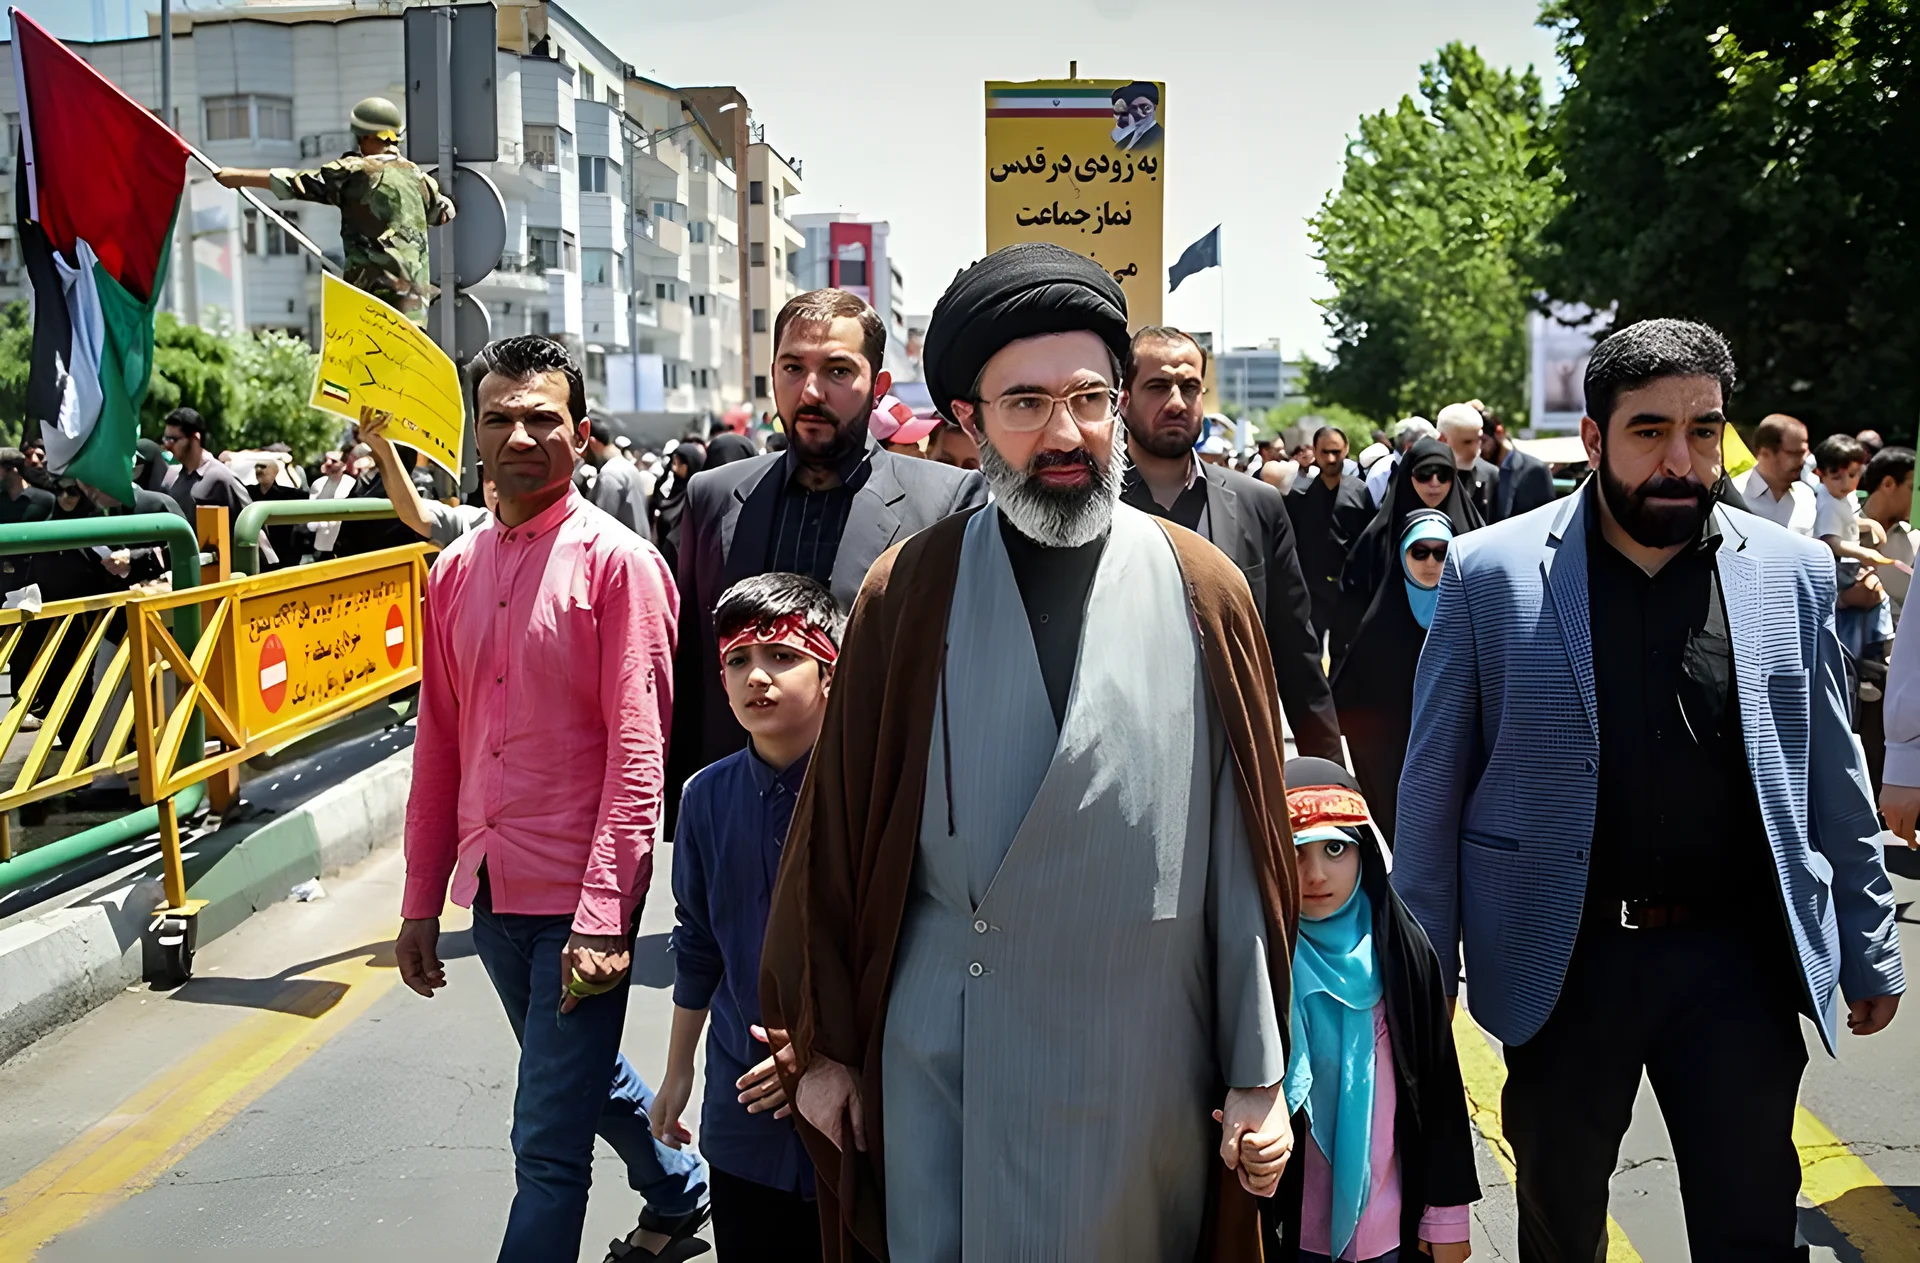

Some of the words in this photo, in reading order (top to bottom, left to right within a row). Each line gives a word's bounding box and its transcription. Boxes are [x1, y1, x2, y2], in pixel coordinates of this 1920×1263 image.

[990, 147, 1046, 182] قدس
[1046, 154, 1071, 182] در
[1075, 153, 1134, 182] زودی
[1137, 155, 1157, 181] به
[1016, 201, 1091, 233] جماعت
[1092, 201, 1132, 234] نماز
